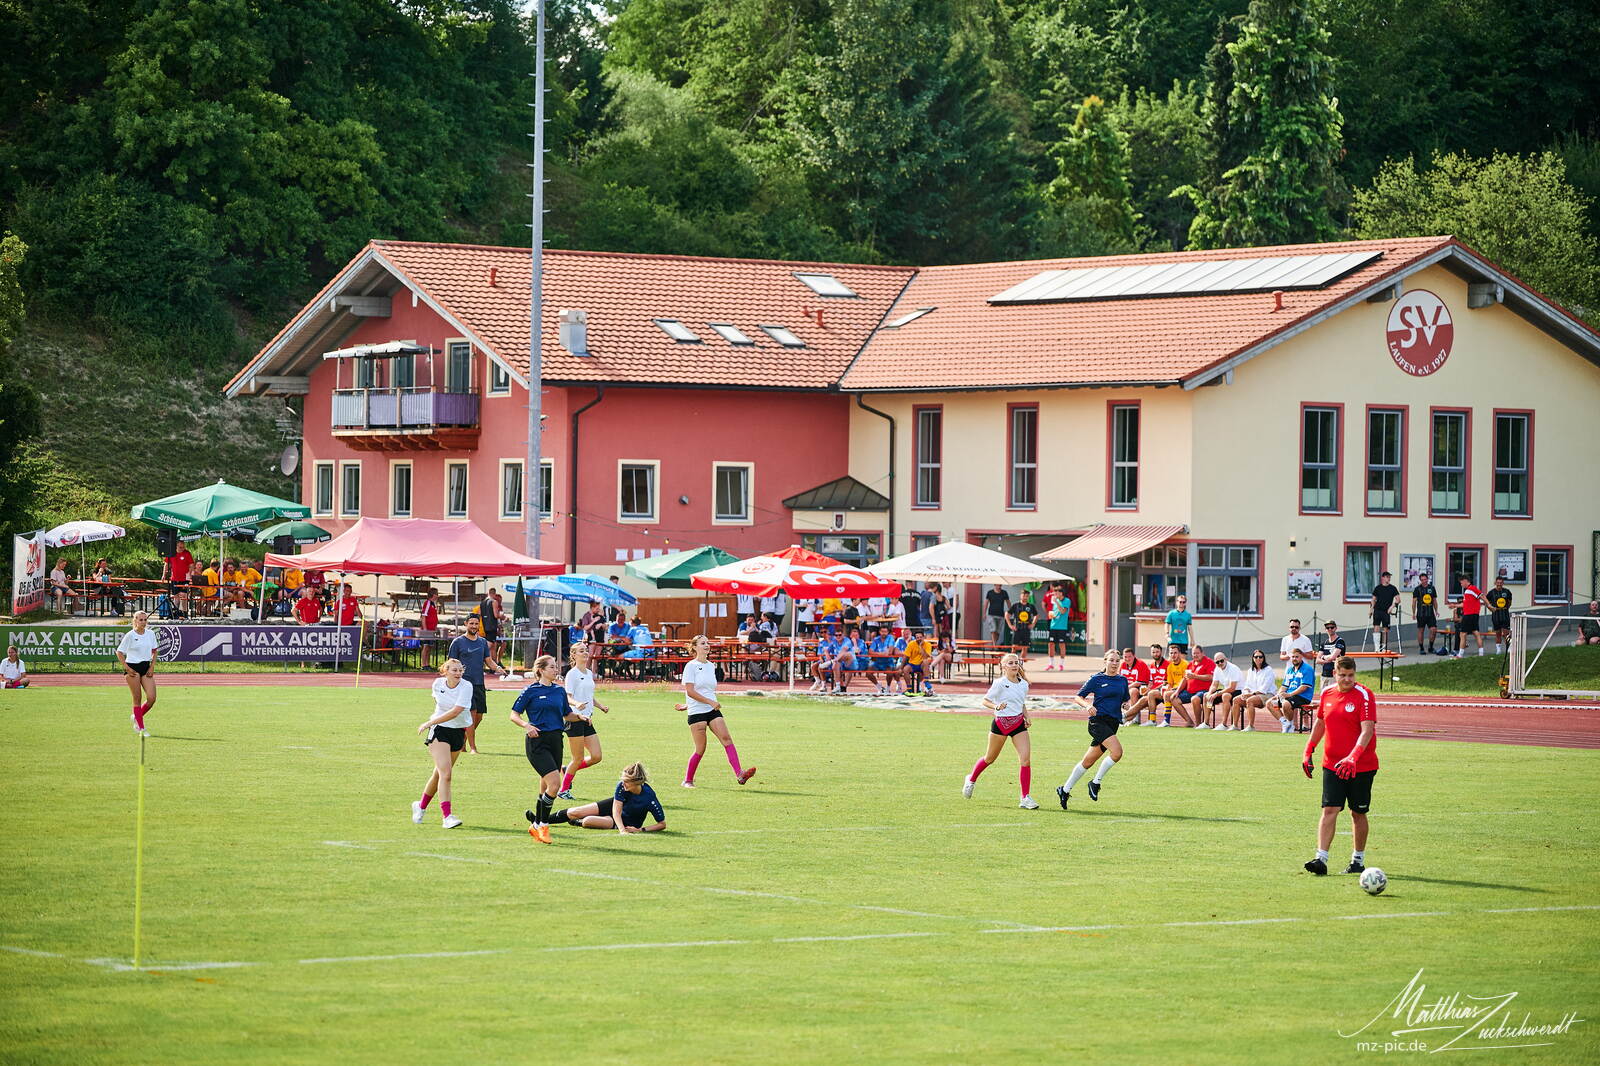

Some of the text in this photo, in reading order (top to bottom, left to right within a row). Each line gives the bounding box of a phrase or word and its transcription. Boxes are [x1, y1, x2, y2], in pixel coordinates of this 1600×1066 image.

[1400, 305, 1443, 348] SV
[1390, 341, 1416, 374] LAUFEN
[1431, 348, 1447, 369] 1927
[8, 631, 54, 646] MAX
[241, 632, 352, 646] MAX AICHER
[17, 647, 54, 655] MWELT
[57, 647, 66, 656] &
[241, 647, 353, 656] UNTERNEHMENSGRUPPE
